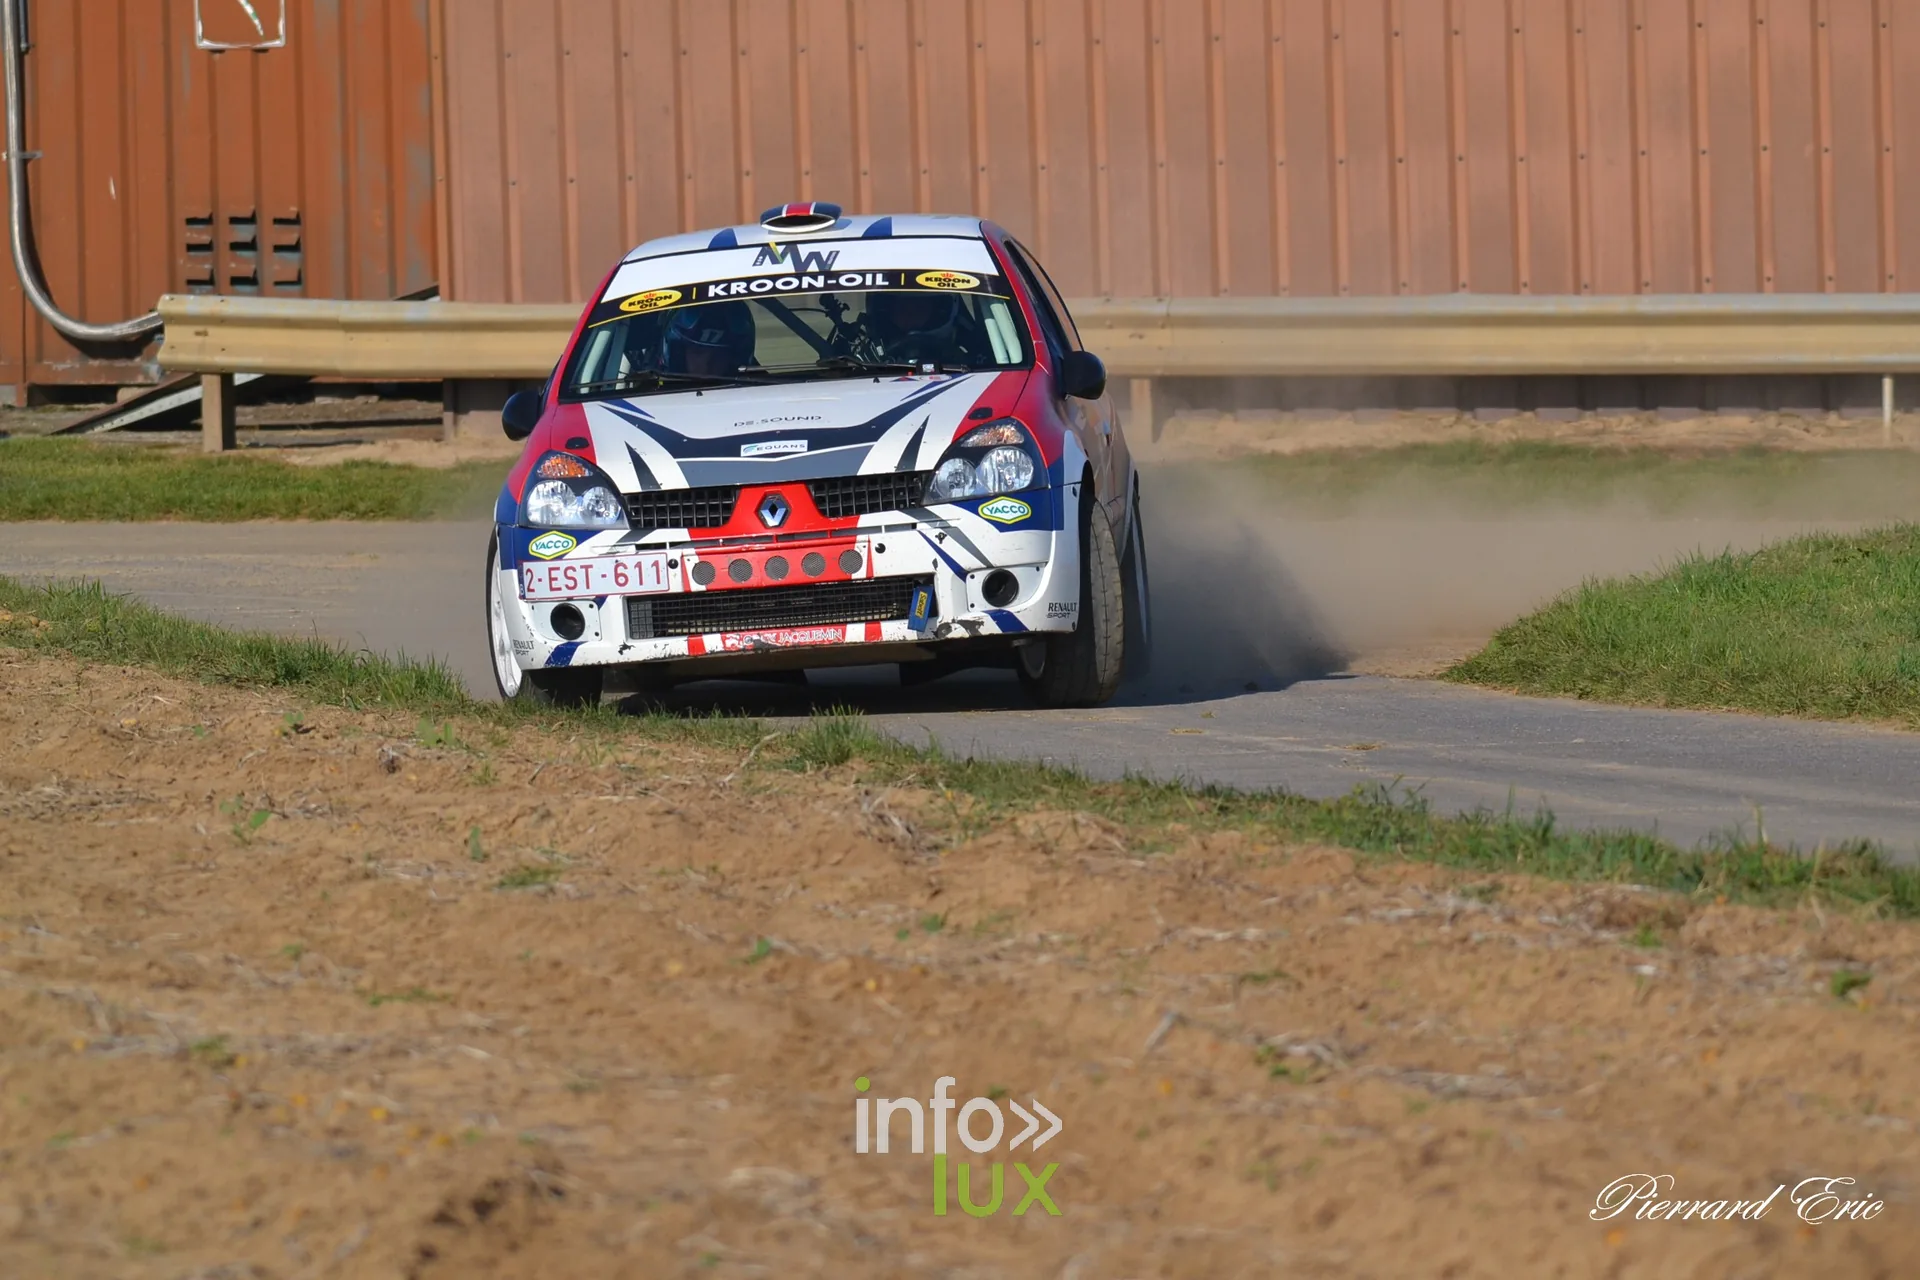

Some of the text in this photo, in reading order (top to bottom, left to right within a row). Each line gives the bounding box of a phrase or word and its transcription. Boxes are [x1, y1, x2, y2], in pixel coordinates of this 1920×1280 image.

[707, 273, 889, 298] KROON-OIL
[924, 276, 971, 285] KROON
[628, 294, 673, 307] KROON
[639, 302, 659, 310] OIL
[756, 443, 806, 452] EQUANS
[985, 504, 1026, 515] YACCO
[534, 539, 570, 551] YACCO
[1047, 602, 1077, 612] RENAULT
